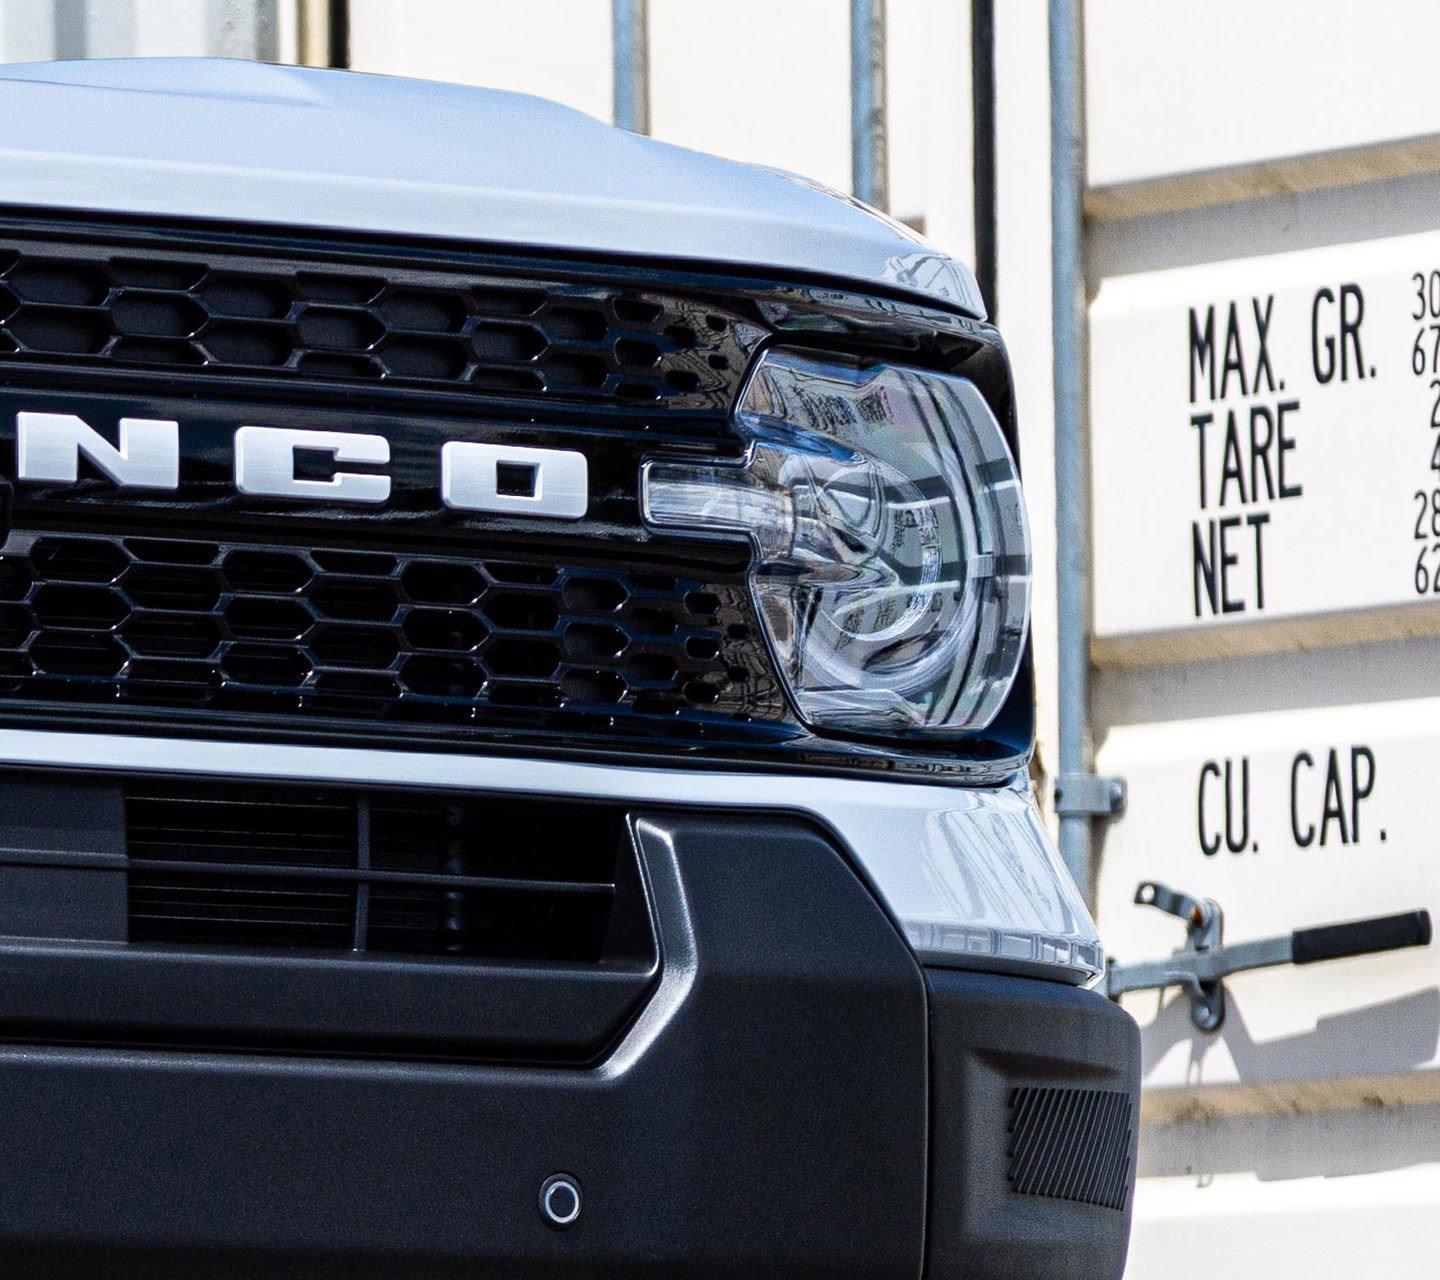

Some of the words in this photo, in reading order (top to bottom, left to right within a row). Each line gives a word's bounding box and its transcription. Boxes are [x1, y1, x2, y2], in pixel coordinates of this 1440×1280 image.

[1188, 294, 1285, 404] MAX.
[1311, 282, 1377, 385] GR.
[1412, 269, 1440, 320] 30
[1412, 326, 1440, 376] 67
[1190, 400, 1304, 509] TARE
[1192, 513, 1271, 617] NET
[1197, 756, 1259, 856] CU.
[1290, 744, 1387, 848] CAP.
